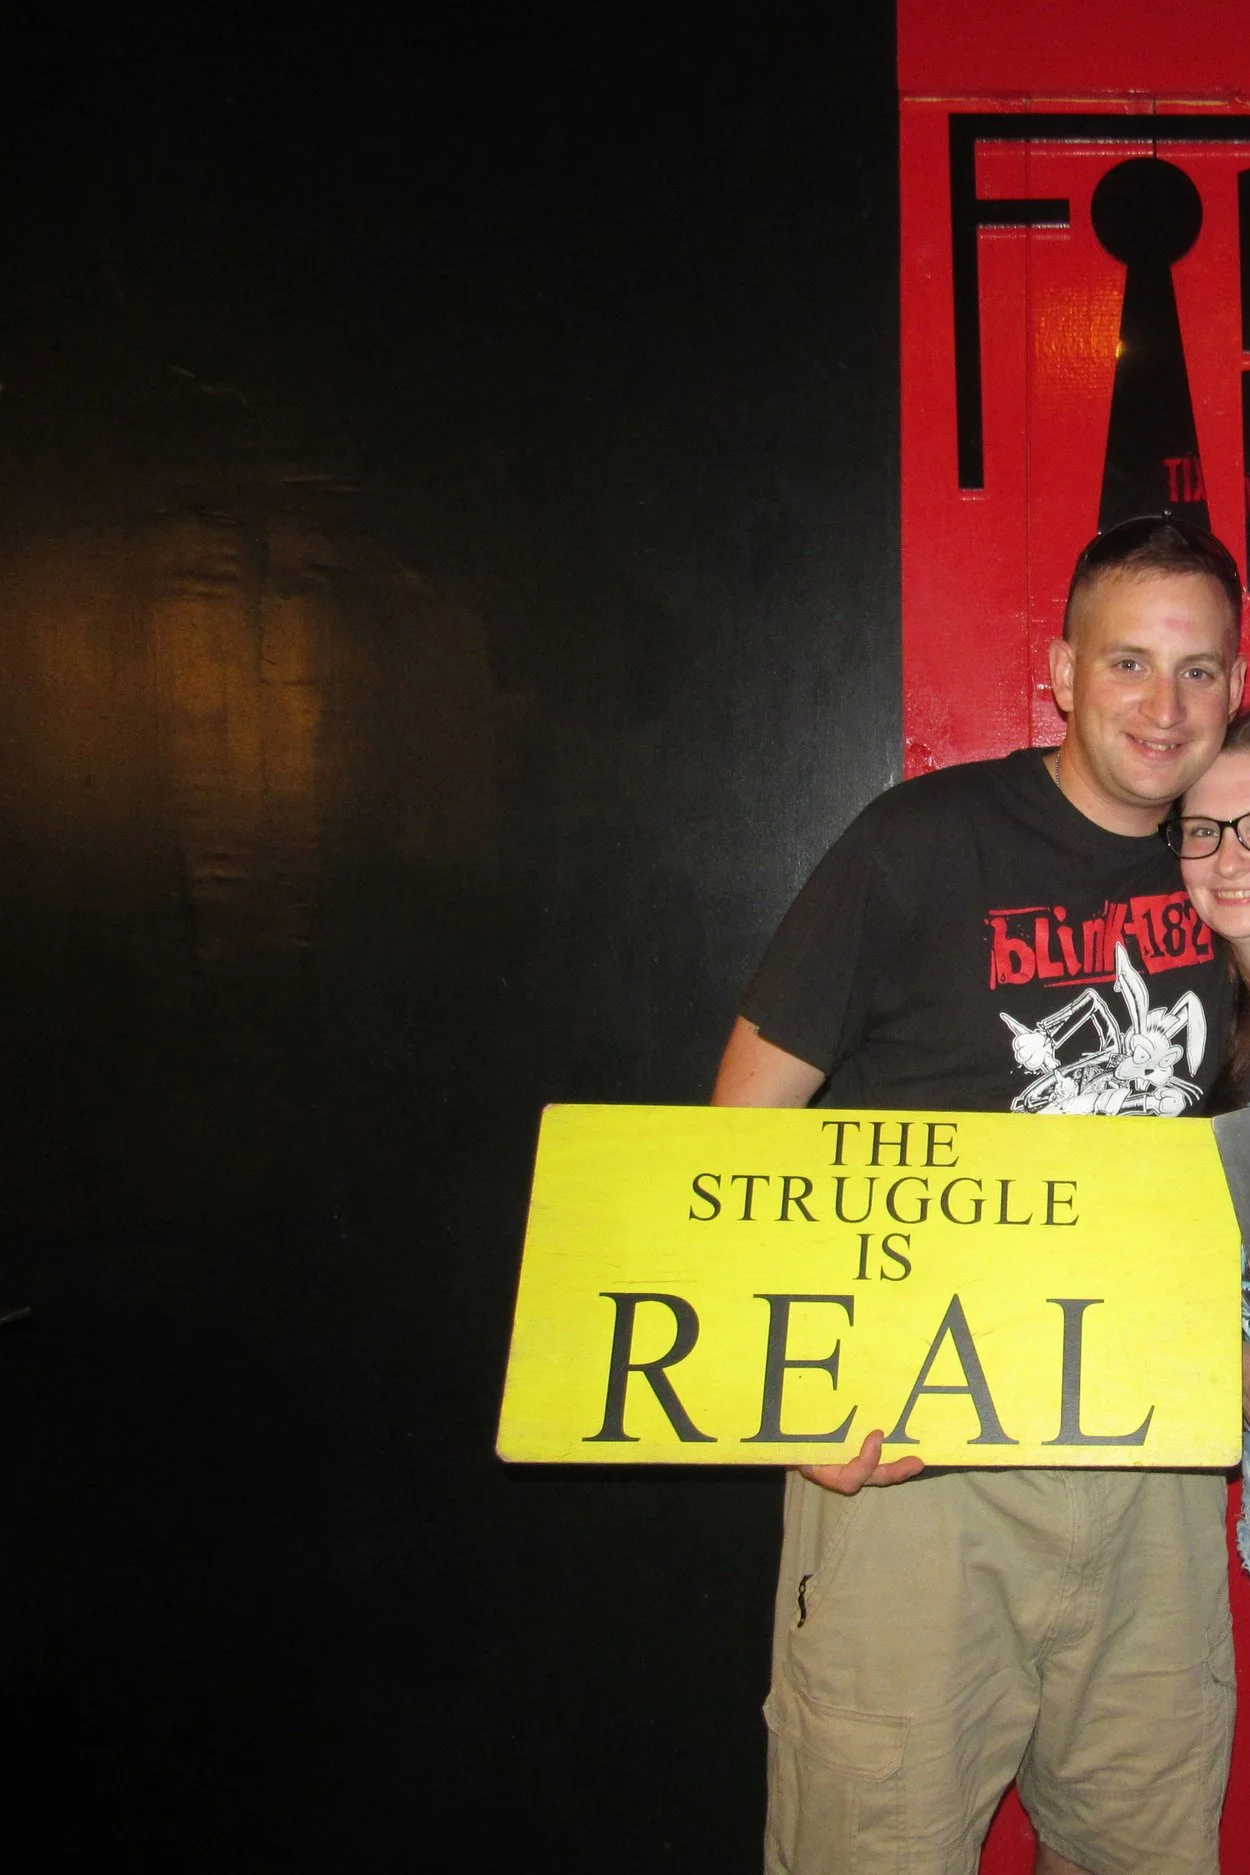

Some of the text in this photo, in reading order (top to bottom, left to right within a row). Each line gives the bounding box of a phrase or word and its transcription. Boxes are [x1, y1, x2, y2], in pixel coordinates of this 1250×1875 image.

[821, 1121, 960, 1167] THE
[688, 1172, 1080, 1226] STRUGGLE
[852, 1232, 913, 1282] IS
[581, 1292, 1156, 1446] REAL
